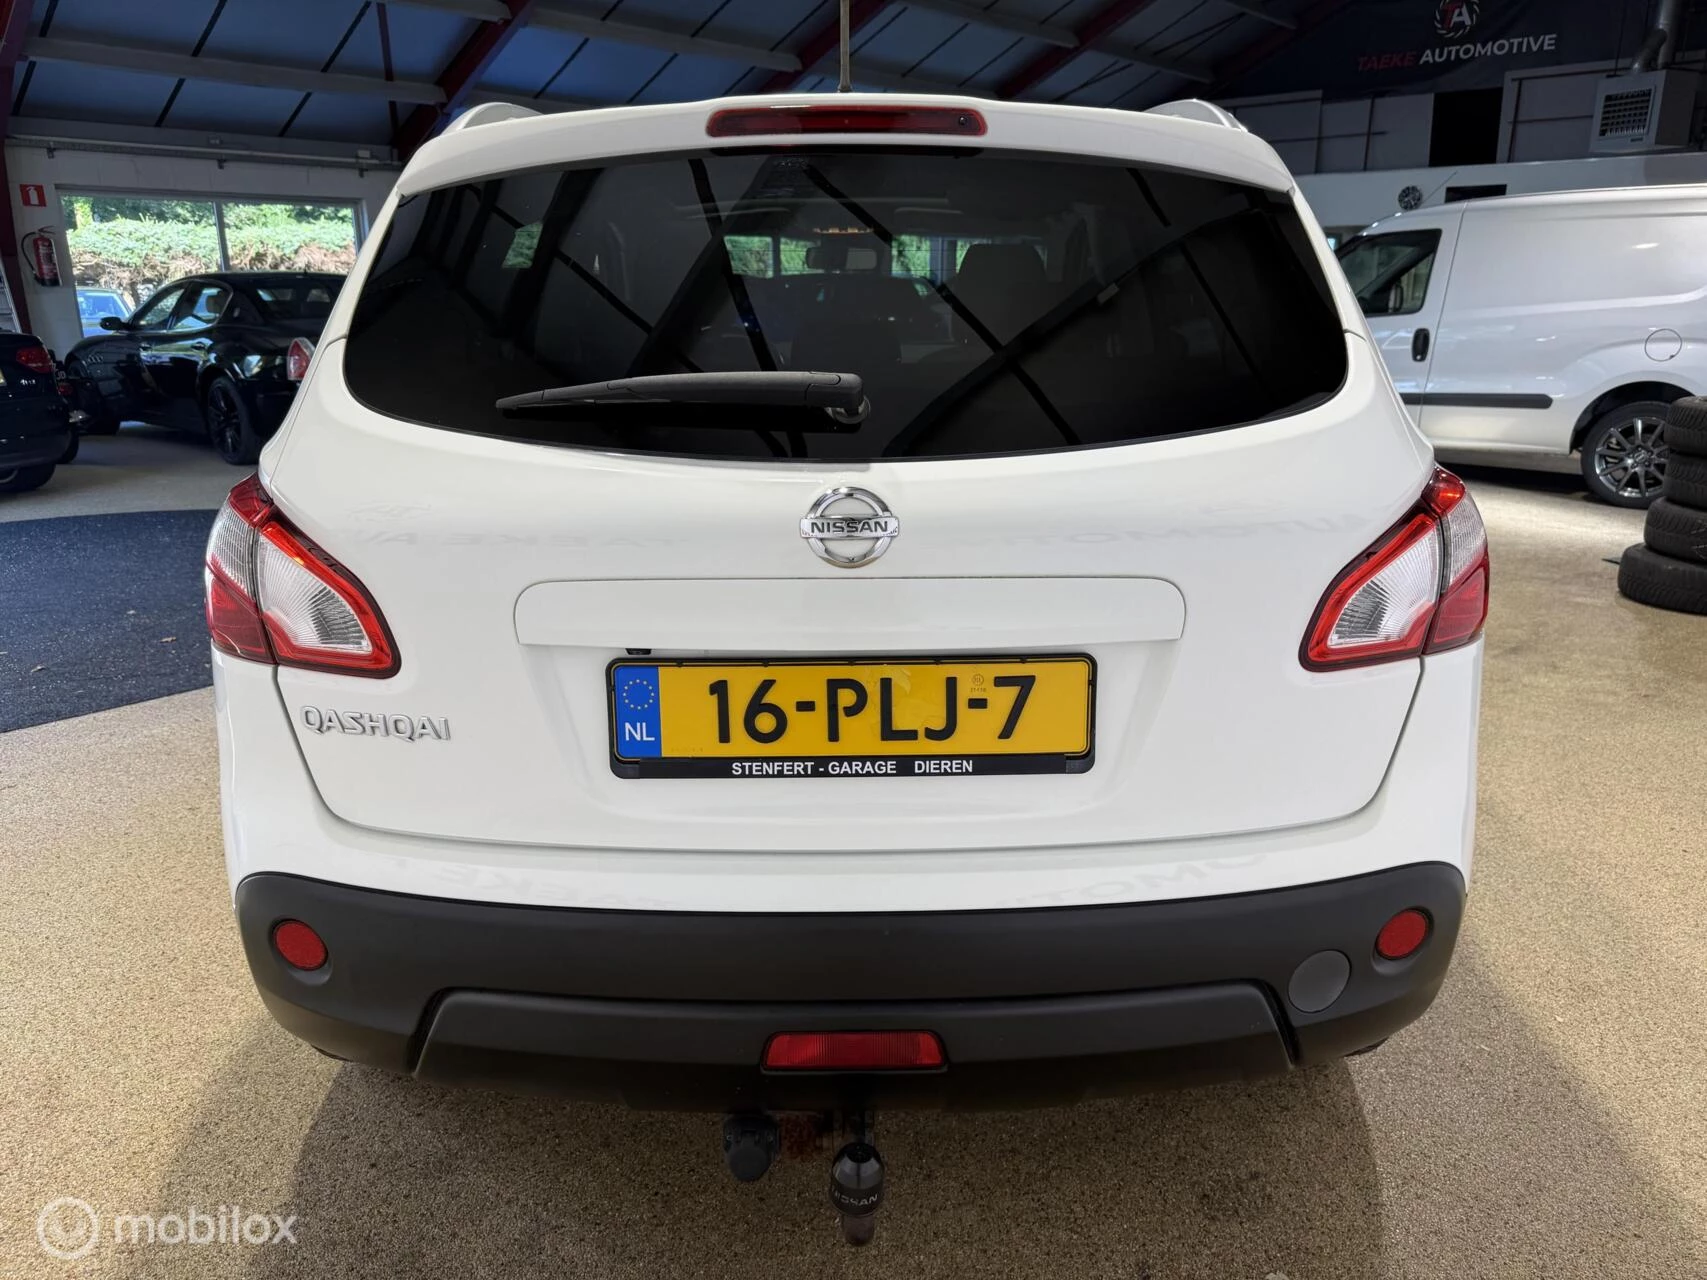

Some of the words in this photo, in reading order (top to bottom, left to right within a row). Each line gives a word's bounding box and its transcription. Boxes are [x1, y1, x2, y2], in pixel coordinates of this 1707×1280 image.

[1357, 50, 1417, 72] TAEKE
[1419, 33, 1558, 65] AUTOMOTIVE
[811, 520, 888, 534] NISSAN
[300, 705, 451, 742] QASHQAI
[708, 674, 1037, 744] 16-PLJ-7
[624, 721, 656, 743] NL
[731, 761, 814, 776] STENFERT
[828, 761, 897, 775] GARAGE
[914, 760, 973, 774] DIEREN
